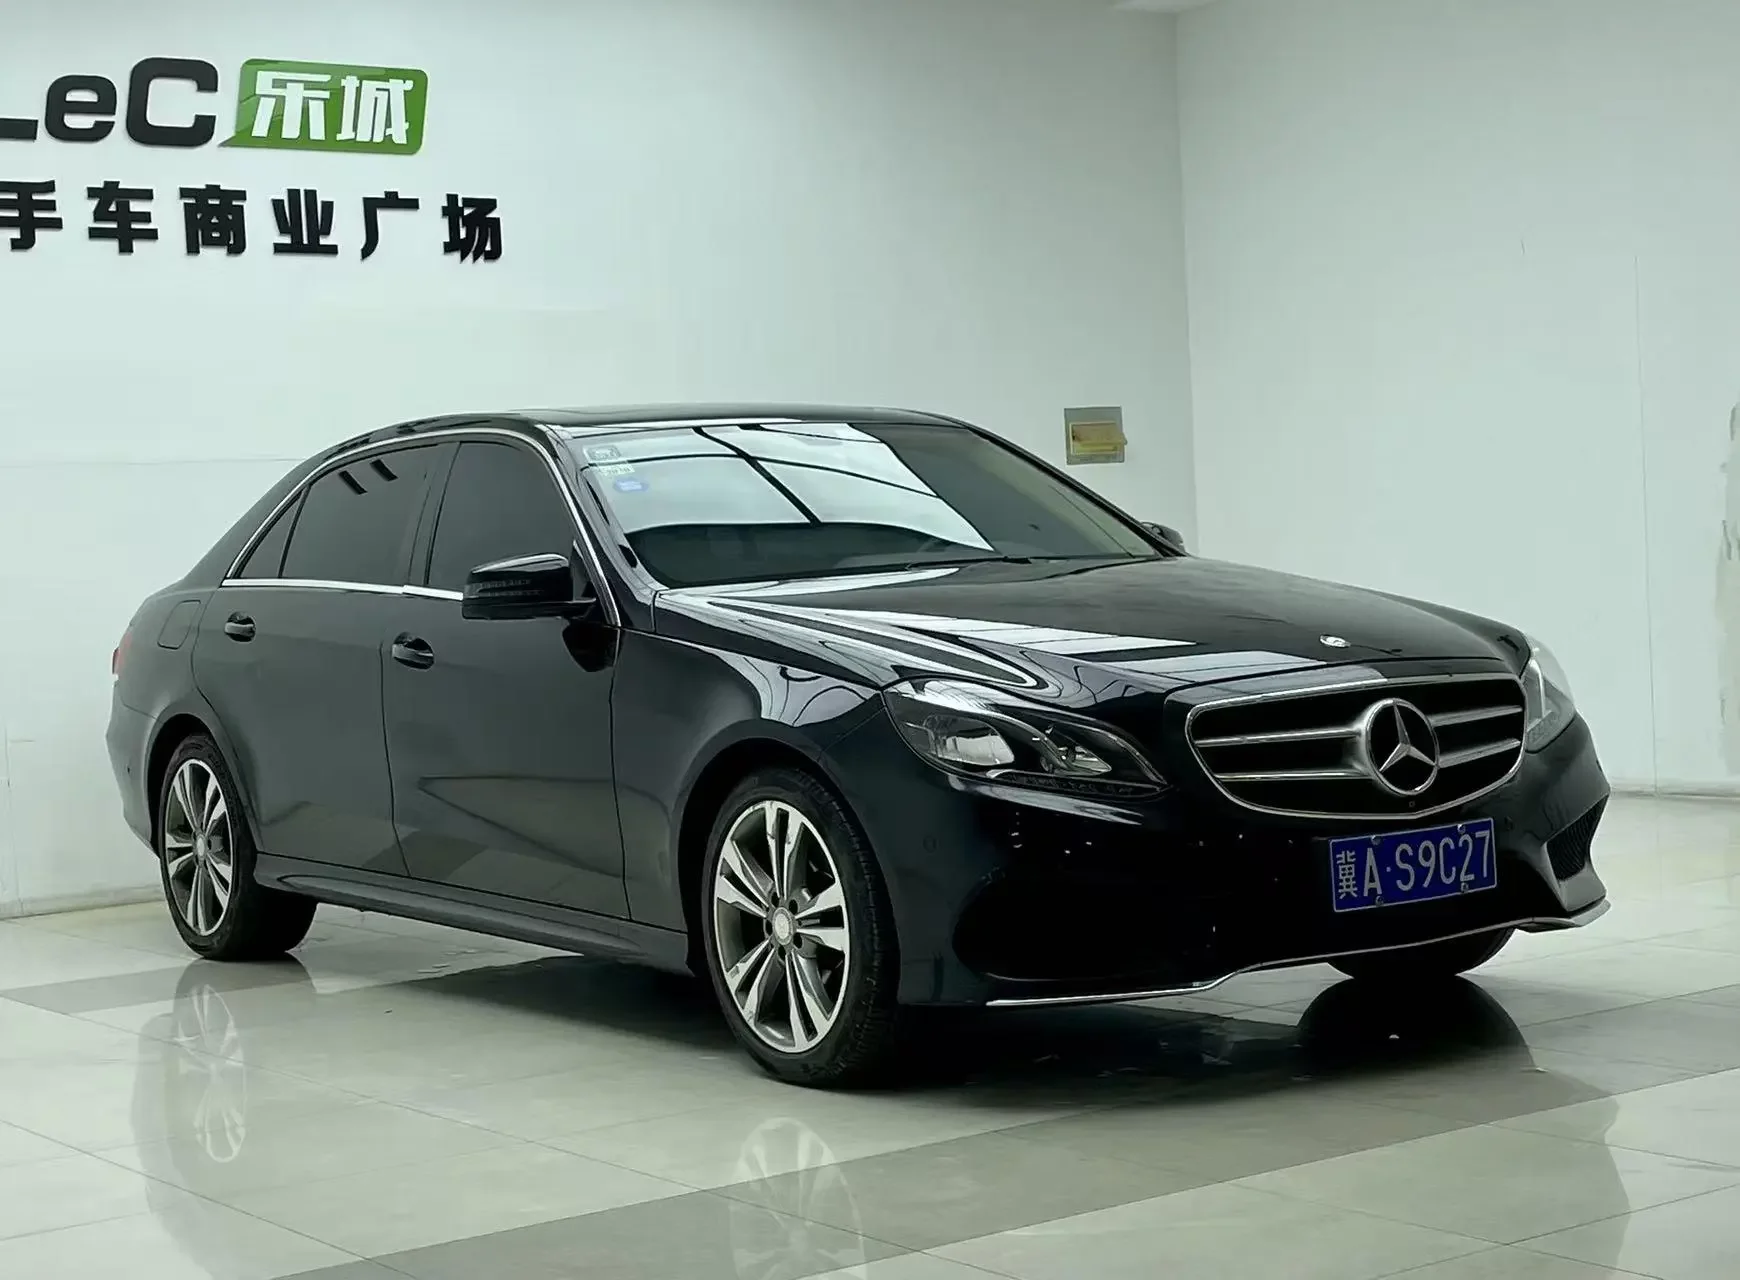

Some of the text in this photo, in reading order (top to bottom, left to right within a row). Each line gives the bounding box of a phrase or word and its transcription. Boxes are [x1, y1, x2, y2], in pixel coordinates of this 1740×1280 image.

[251, 70, 414, 144] 乐城
[0, 180, 502, 263] 手车商业广场
